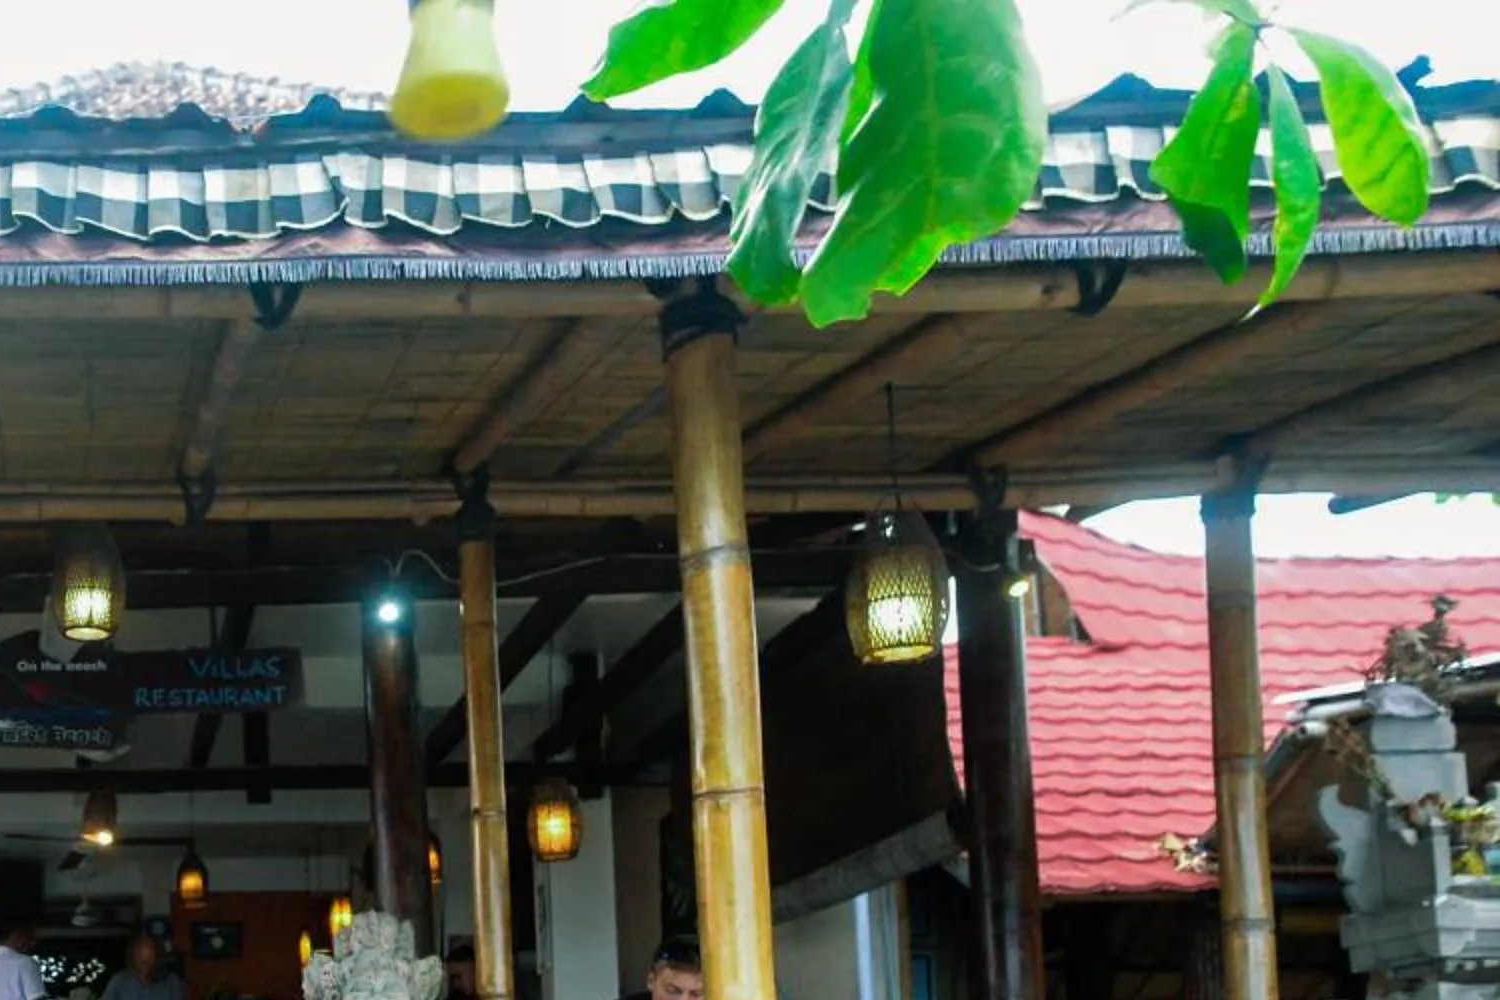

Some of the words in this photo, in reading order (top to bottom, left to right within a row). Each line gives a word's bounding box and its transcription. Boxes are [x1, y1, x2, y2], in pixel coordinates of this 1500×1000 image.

[16, 661, 35, 672] On
[41, 660, 62, 672] the
[134, 686, 288, 707] RESTAURANT
